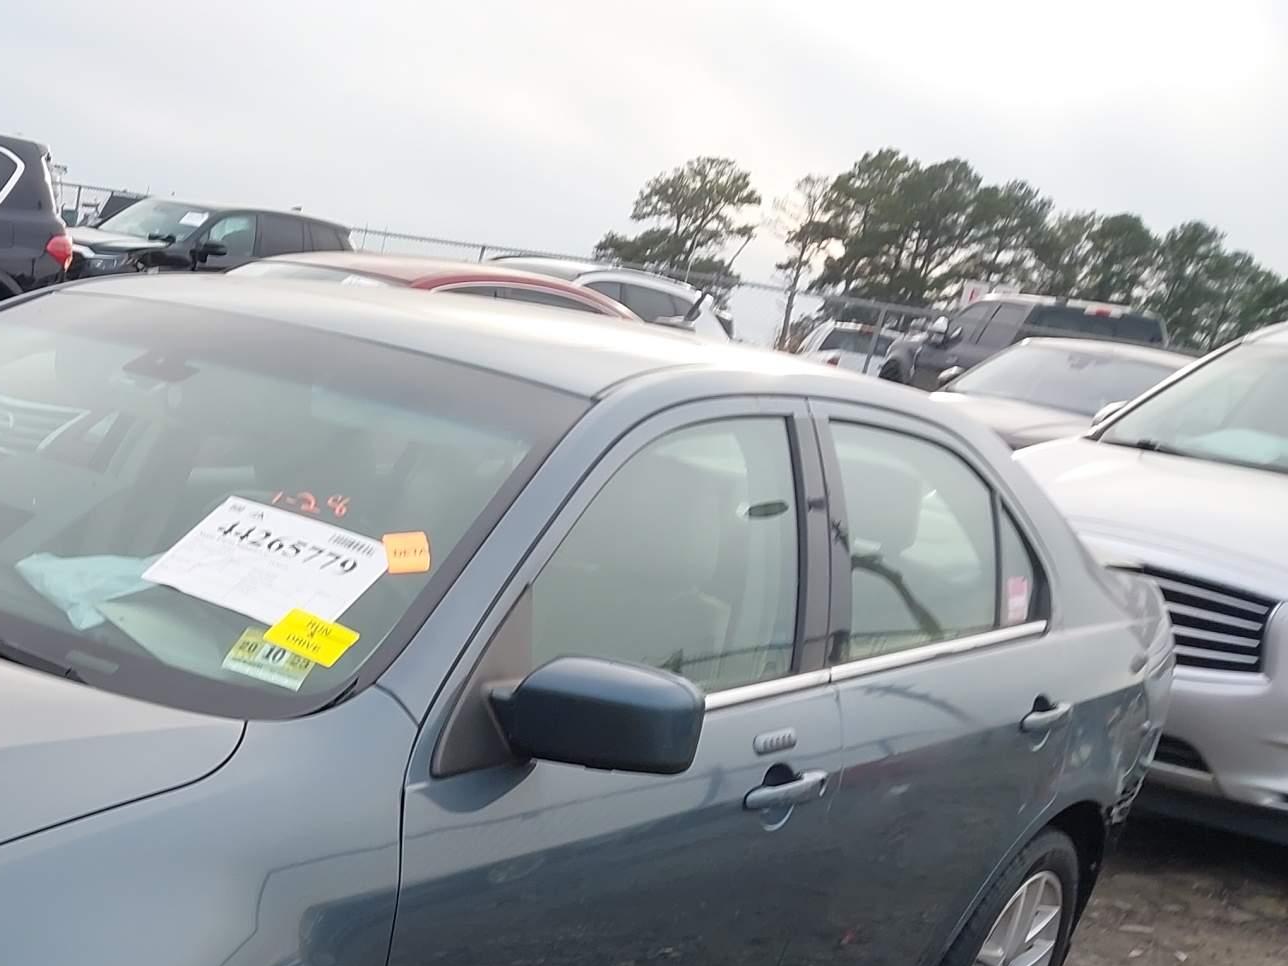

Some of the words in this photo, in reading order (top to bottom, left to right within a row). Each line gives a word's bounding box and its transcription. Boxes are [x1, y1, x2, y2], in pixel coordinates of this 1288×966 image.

[217, 521, 358, 575] 44265779
[306, 619, 333, 637] RUN
[286, 632, 321, 654] DRIVE
[263, 645, 287, 665] 10
